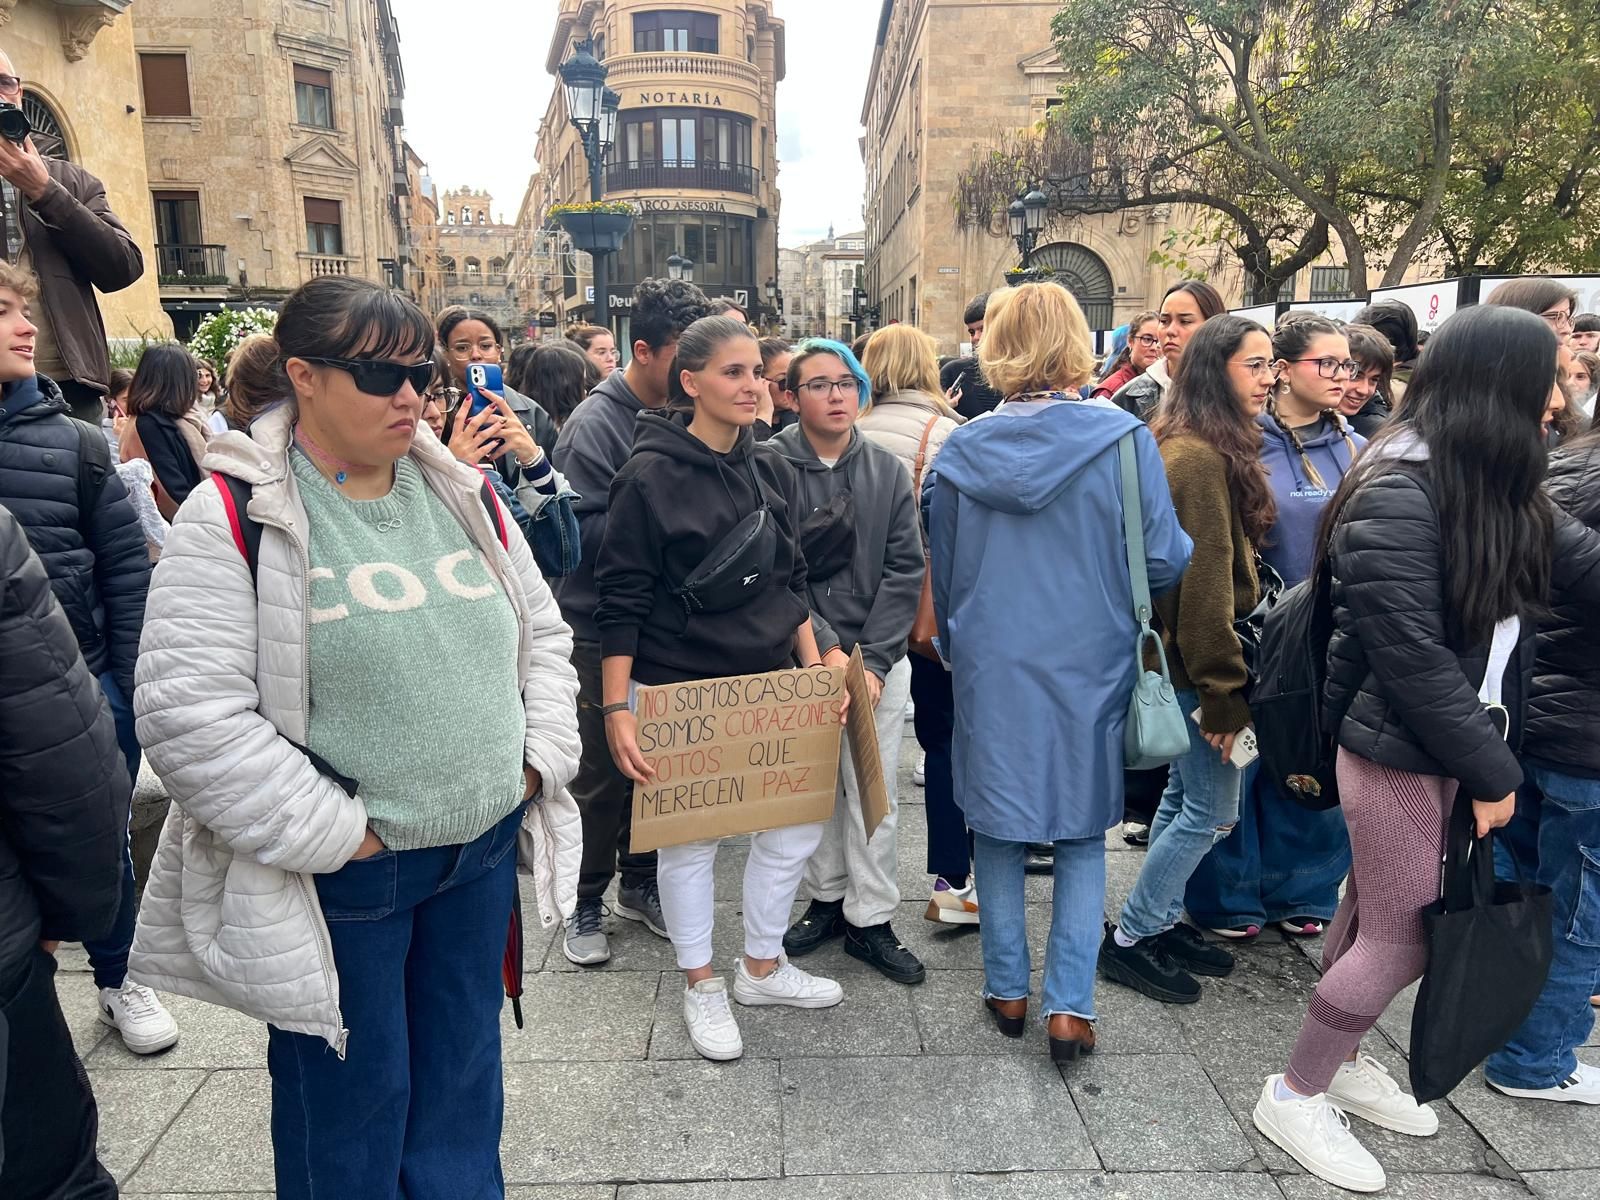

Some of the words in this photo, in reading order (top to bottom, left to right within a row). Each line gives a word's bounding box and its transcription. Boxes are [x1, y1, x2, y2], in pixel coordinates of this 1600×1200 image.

[640, 92, 722, 106] NOTARÍA
[309, 549, 498, 624] COC
[643, 689, 668, 719] NO
[674, 678, 741, 713] SOMOS
[640, 714, 715, 753] SOMOS
[725, 699, 841, 737] CORAZONES
[748, 737, 797, 766] QUE
[641, 776, 744, 819] MERECEN
[762, 767, 812, 797] PAZ
